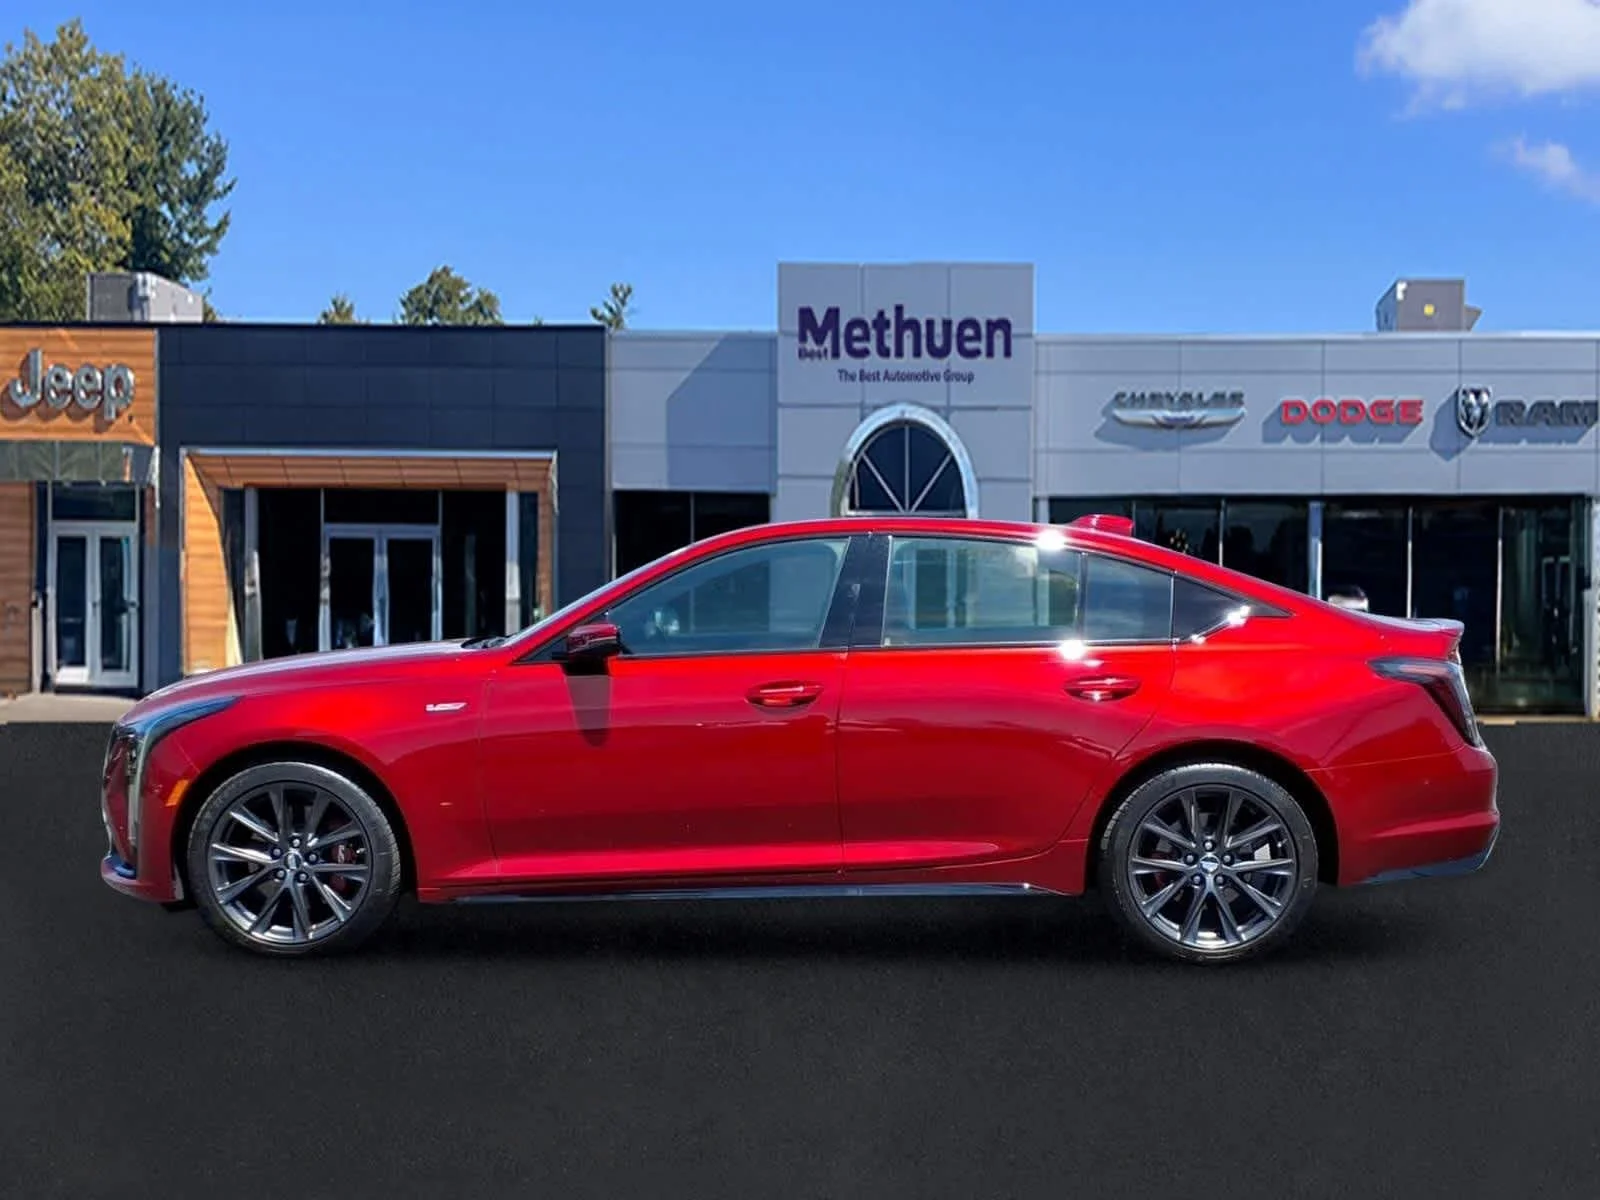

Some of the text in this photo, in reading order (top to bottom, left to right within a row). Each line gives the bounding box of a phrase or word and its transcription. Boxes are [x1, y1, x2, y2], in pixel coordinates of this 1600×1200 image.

[798, 304, 1012, 359] Methuen
[9, 348, 135, 420] Jeep
[838, 369, 974, 384] The Best Automotive Group
[1280, 399, 1424, 424] DODGE
[1495, 400, 1598, 426] RAM
